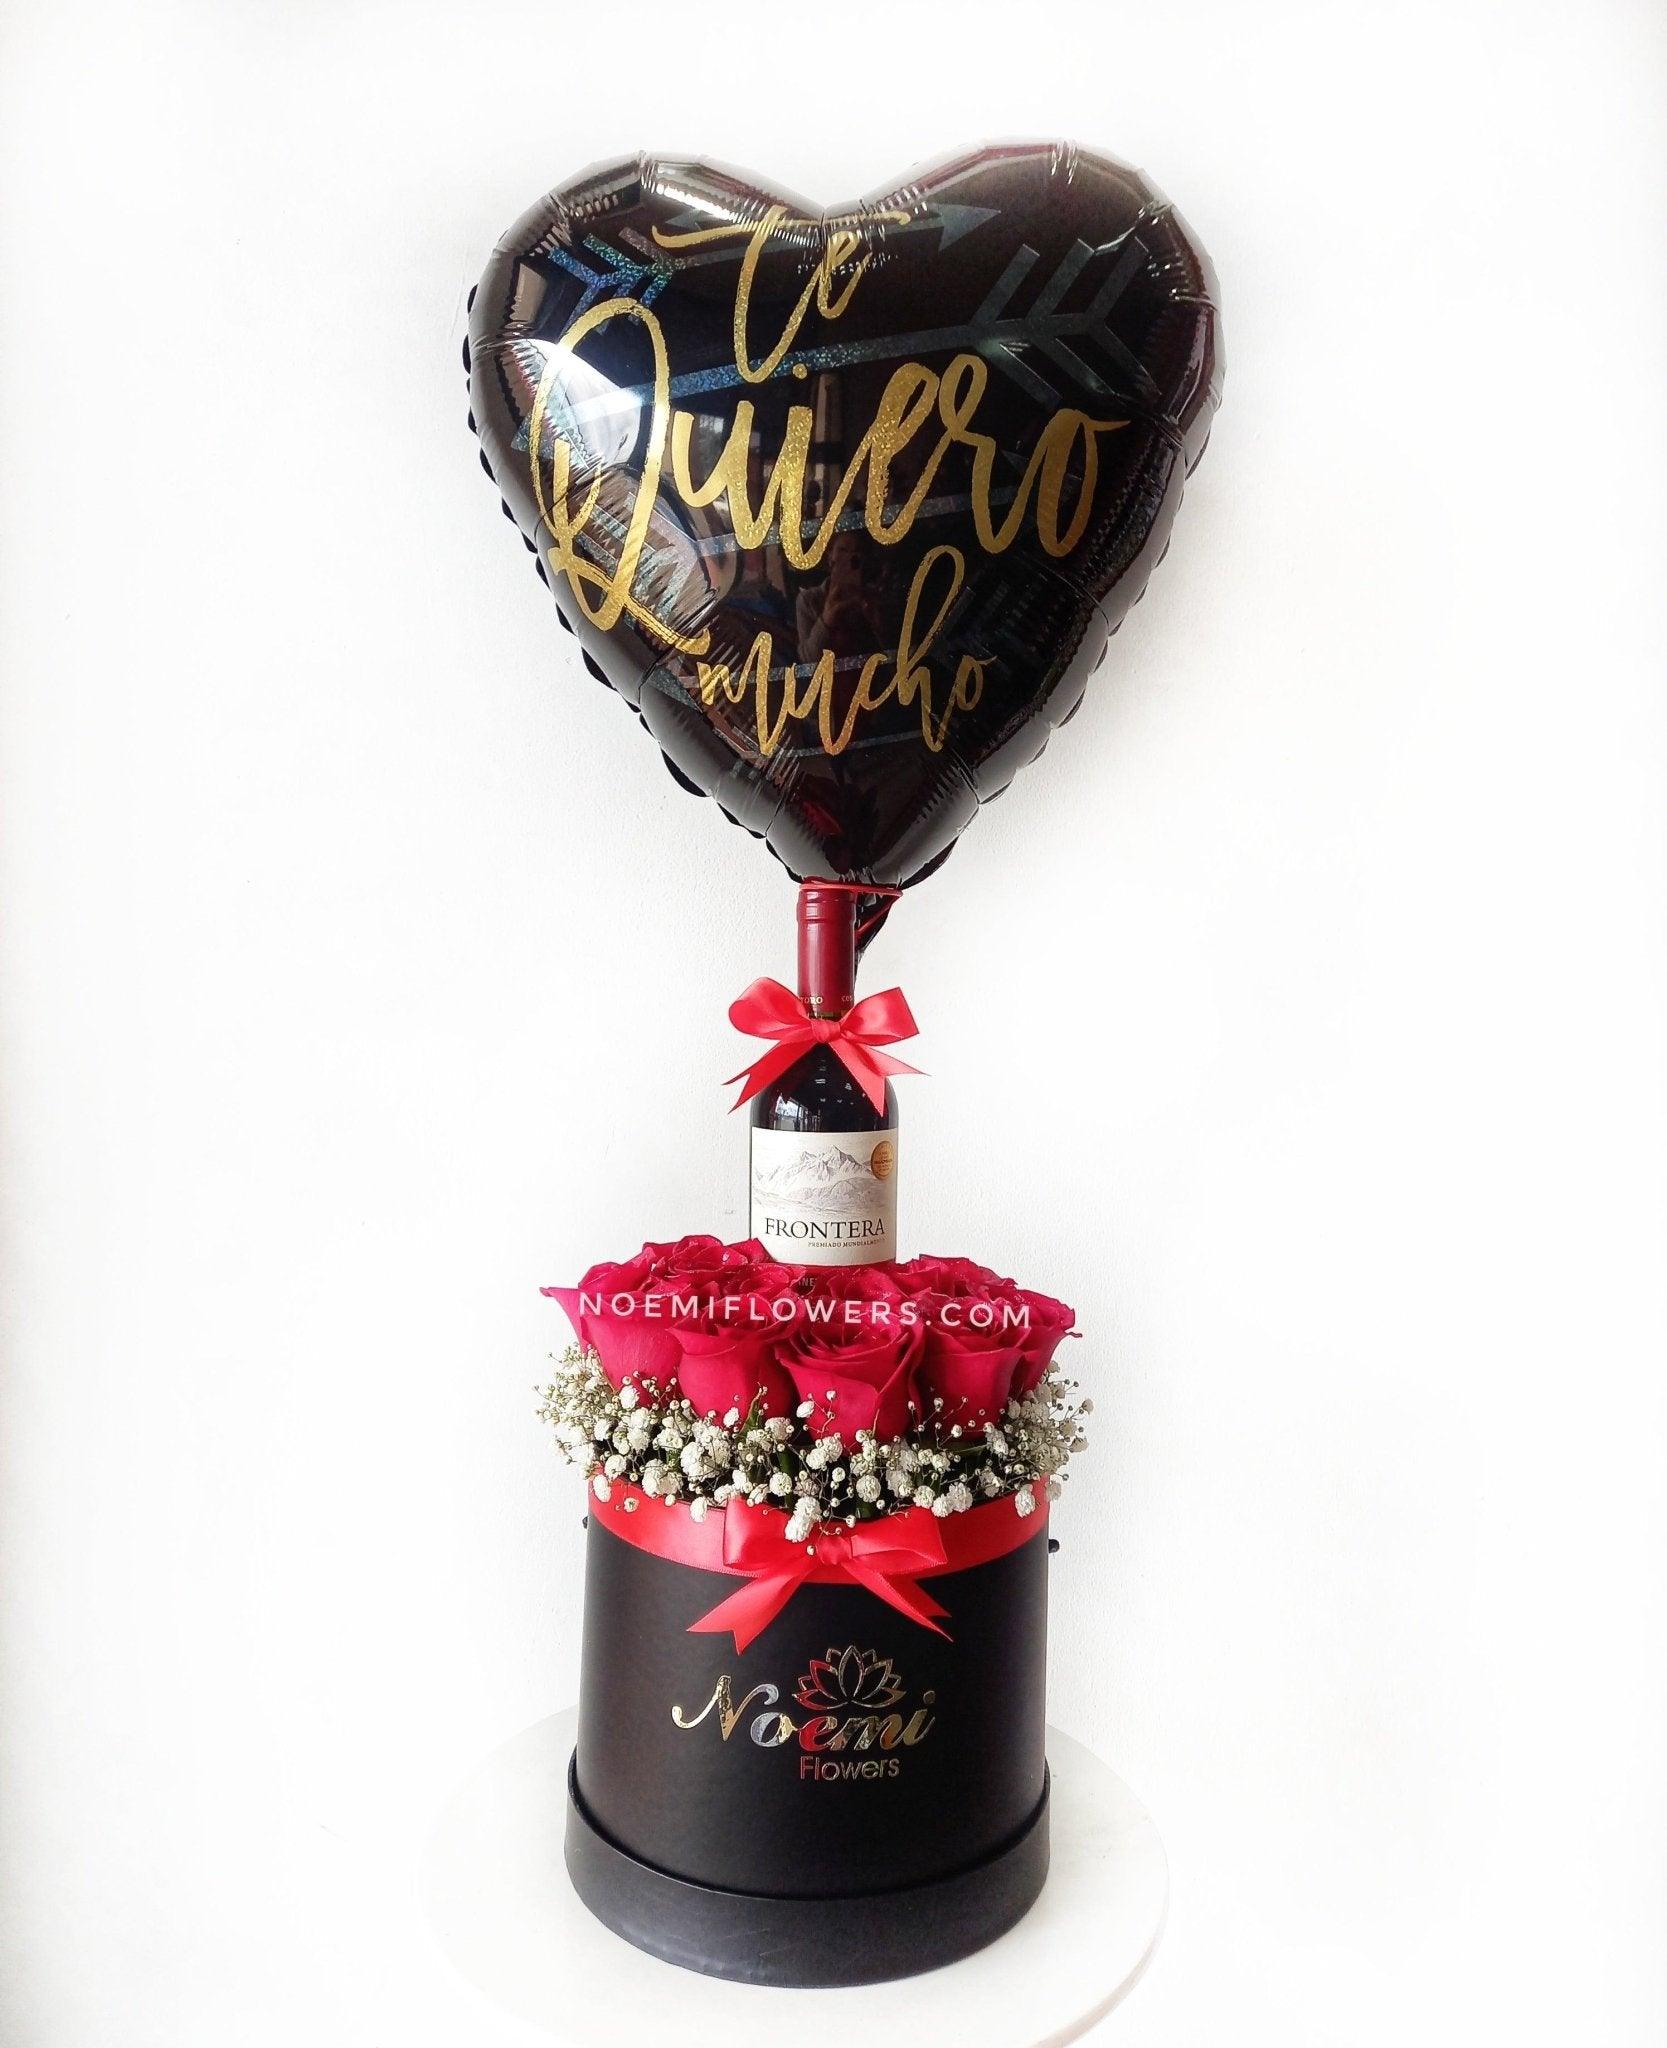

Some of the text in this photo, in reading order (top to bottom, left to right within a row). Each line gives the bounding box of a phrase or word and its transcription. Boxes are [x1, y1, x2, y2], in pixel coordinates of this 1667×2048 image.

[652, 205, 911, 383] Te
[531, 297, 1131, 655] Quiero
[697, 546, 997, 754] mucho
[765, 1217, 885, 1239] FRONTERA
[671, 1675, 936, 1751] Noemi
[800, 1756, 900, 1781] Flowers
